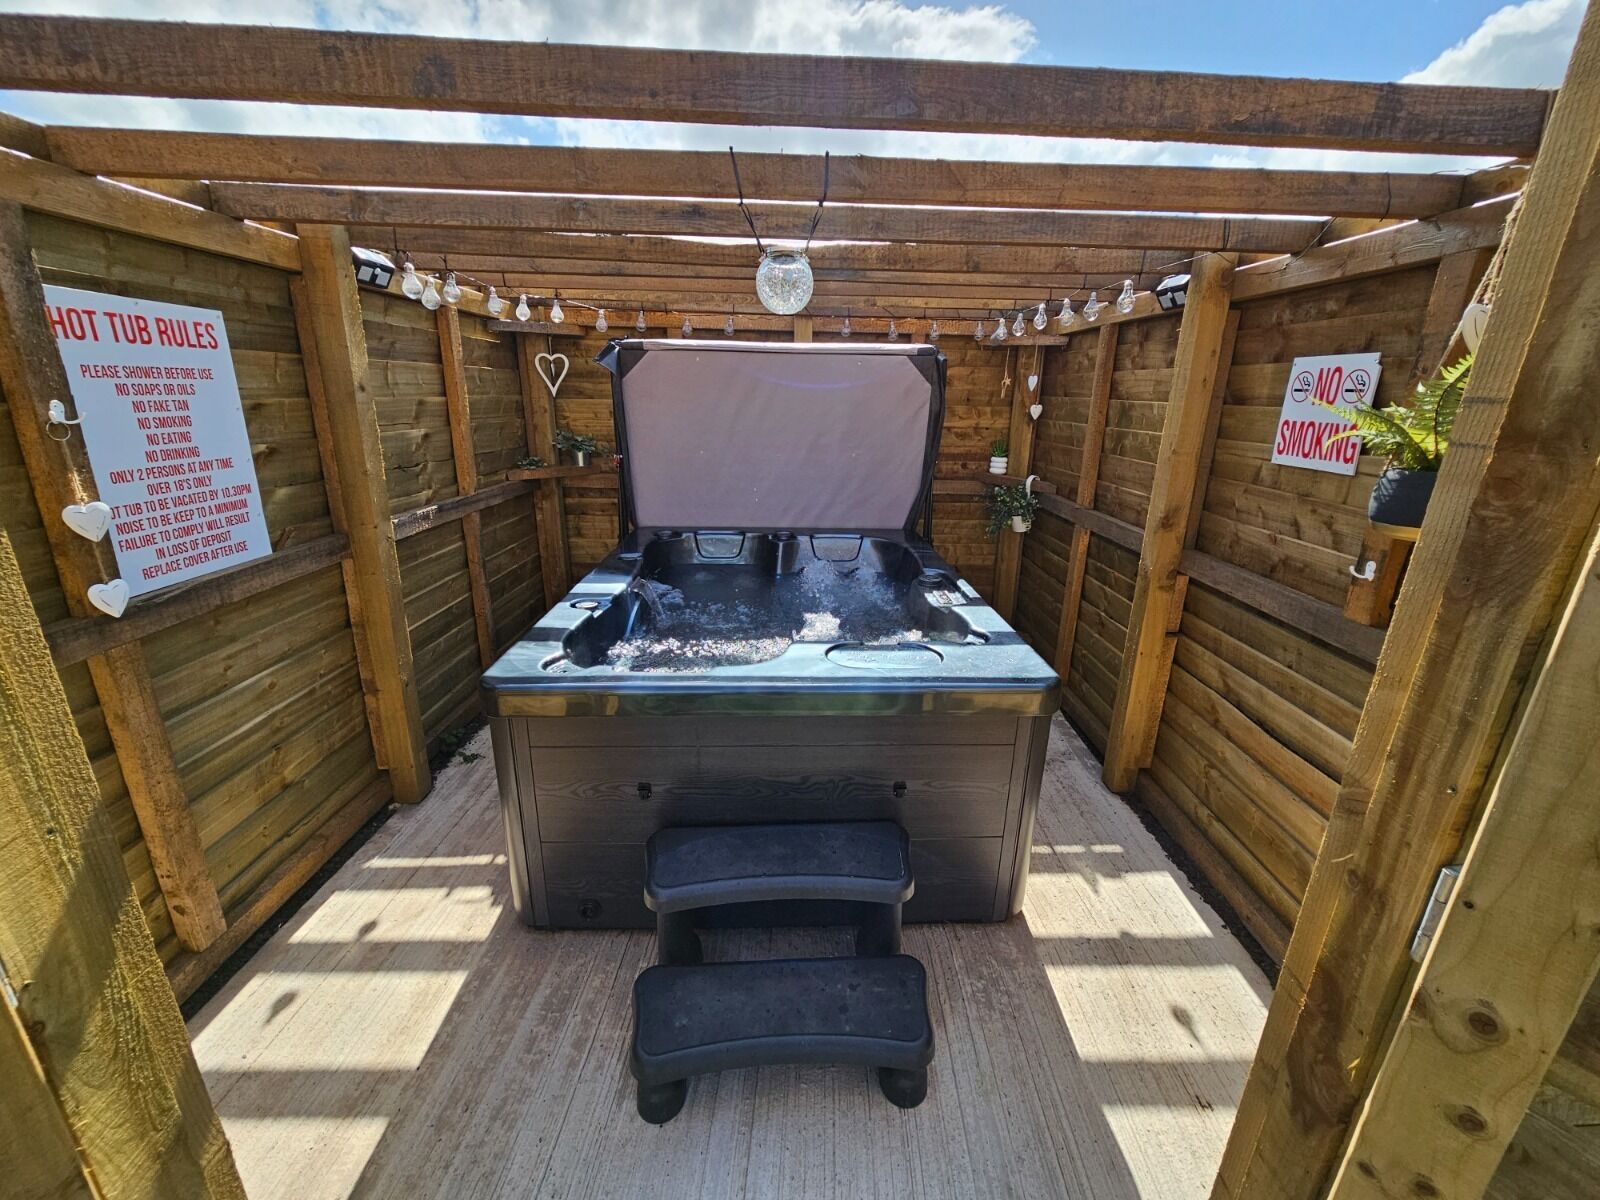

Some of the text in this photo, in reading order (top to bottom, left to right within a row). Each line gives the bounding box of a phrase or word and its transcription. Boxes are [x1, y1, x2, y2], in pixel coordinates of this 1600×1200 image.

[45, 304, 218, 350] HOT TUB RULES
[80, 364, 214, 380] PLEASE SHOWER BEFORE USE
[115, 383, 195, 396] NO SOAPS OR OILS
[1314, 366, 1342, 406] NO
[132, 400, 189, 413] NO FAKE TAN
[137, 416, 192, 430] NO SMOKING
[146, 431, 192, 446] NO EATING
[1277, 420, 1358, 464] SMOKING
[145, 446, 200, 462] NO DRINKING
[110, 458, 234, 484] ONLY 2 PERSONS AT ANY TIME
[147, 476, 212, 496] OVER 18'S ONLY
[124, 504, 143, 516] TUB
[144, 500, 156, 512] TO
[160, 499, 170, 510] BE
[170, 494, 208, 508] VACATED
[209, 491, 218, 500] BY
[221, 484, 252, 498] 10.30PM
[116, 499, 248, 536] NOISE TO BE KEEP TO A MINIMUM
[118, 512, 250, 552] FAILURE TO COMPLY WILL RESULT
[156, 531, 232, 560] IN LOSS OF DEPOSIT
[142, 541, 248, 580] REPLACE COVER AFTER USE
